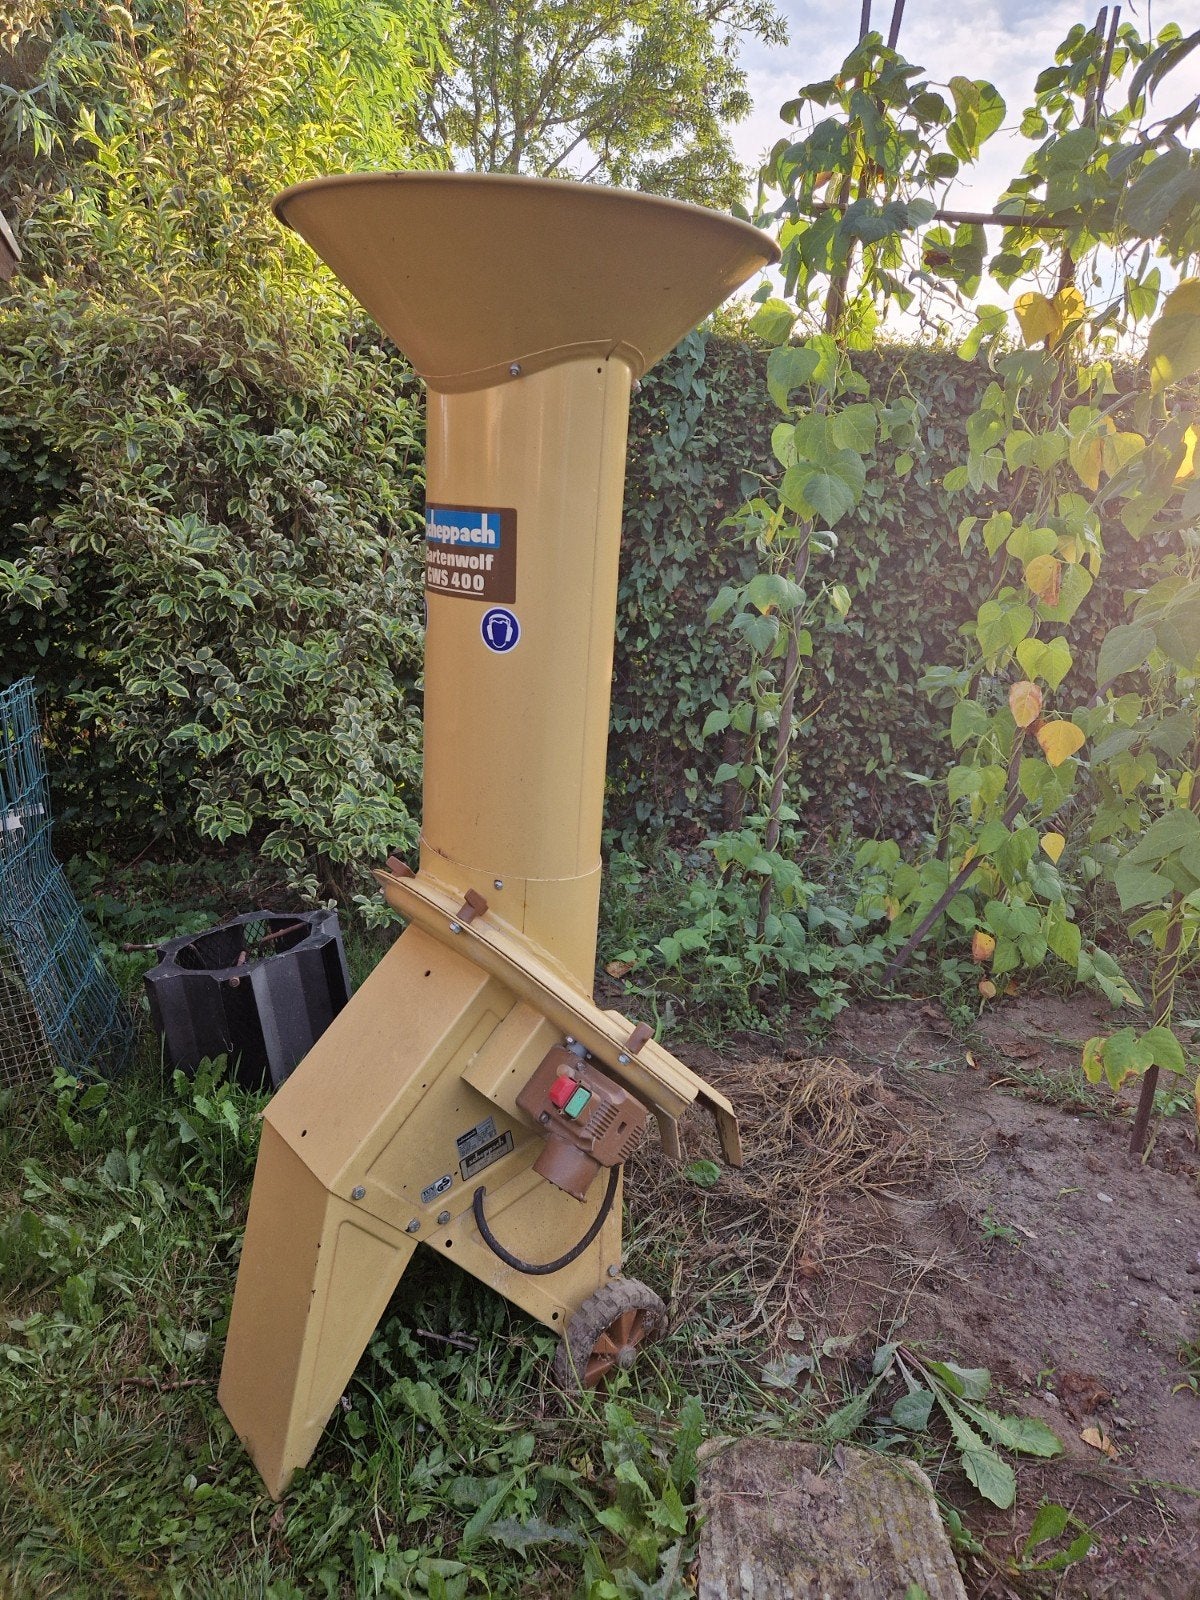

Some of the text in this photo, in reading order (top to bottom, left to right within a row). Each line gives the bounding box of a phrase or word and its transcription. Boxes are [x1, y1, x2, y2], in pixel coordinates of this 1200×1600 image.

[426, 508, 496, 545] cheppach
[427, 566, 485, 591] GWS 400
